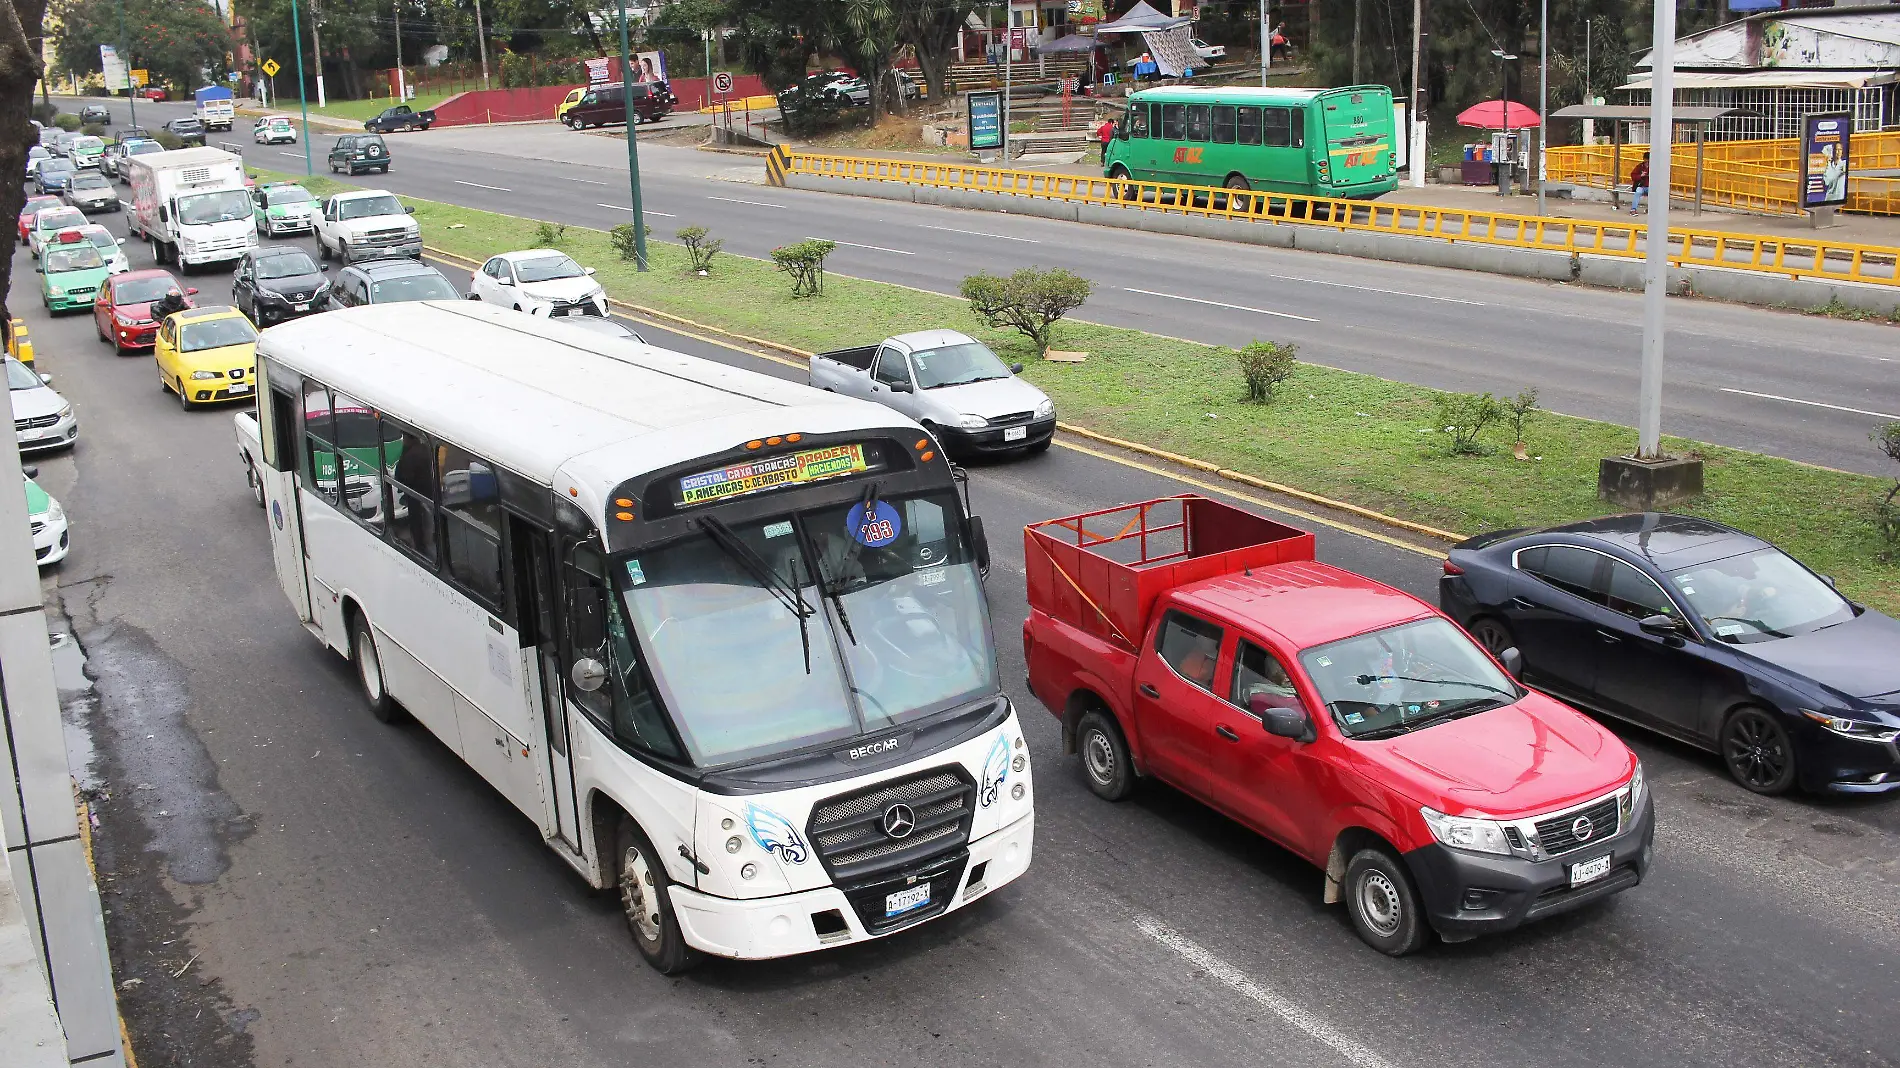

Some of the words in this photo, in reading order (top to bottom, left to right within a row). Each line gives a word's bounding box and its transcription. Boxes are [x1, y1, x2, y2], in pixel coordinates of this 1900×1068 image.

[796, 445, 861, 473] PRADERA
[808, 458, 851, 475] HACIENDAS
[684, 472, 727, 489] CRISTAL
[727, 466, 753, 480] CAXA
[752, 457, 796, 474] TRANCAS
[861, 520, 893, 542] 193
[849, 738, 899, 760] BECCAR
